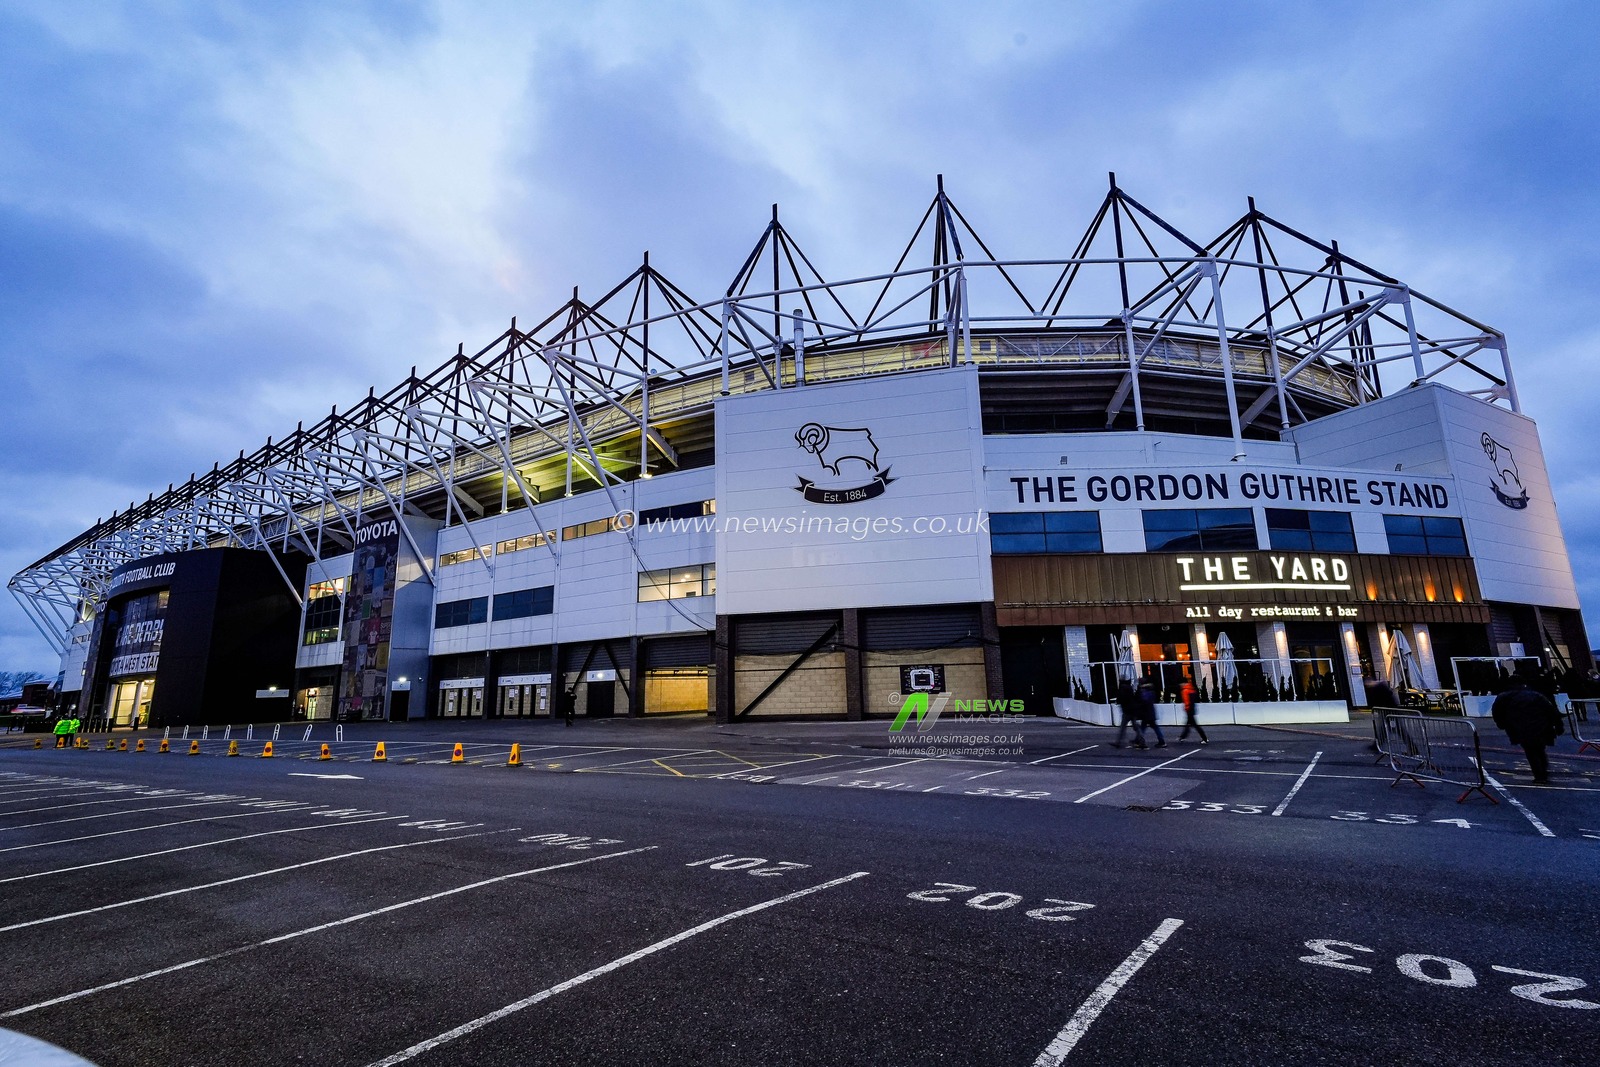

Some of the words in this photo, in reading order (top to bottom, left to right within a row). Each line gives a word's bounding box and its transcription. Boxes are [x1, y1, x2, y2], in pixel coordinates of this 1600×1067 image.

[823, 492, 841, 502] Est.
[845, 489, 867, 501] 1884
[1010, 477, 1077, 503] THE
[1087, 473, 1229, 502] GORDON
[1239, 472, 1360, 504] GUTHRIE
[1366, 480, 1449, 509] STAND
[356, 520, 398, 545] TOYOTA
[124, 566, 152, 584] FOOTBALL
[153, 562, 176, 578] CLUB
[1176, 557, 1250, 581] THE
[1270, 556, 1348, 581] YARD
[1186, 606, 1210, 618] All
[1218, 605, 1243, 619] day
[1250, 605, 1321, 617] restaurant
[1326, 607, 1333, 617] &
[1338, 605, 1358, 617] bar
[964, 787, 1052, 800] 332
[1161, 799, 1268, 816] 333
[1329, 810, 1482, 829] 334
[518, 833, 625, 850] 200
[686, 853, 812, 877] 201
[907, 882, 1096, 922] 202
[1298, 938, 1600, 1011] 203
